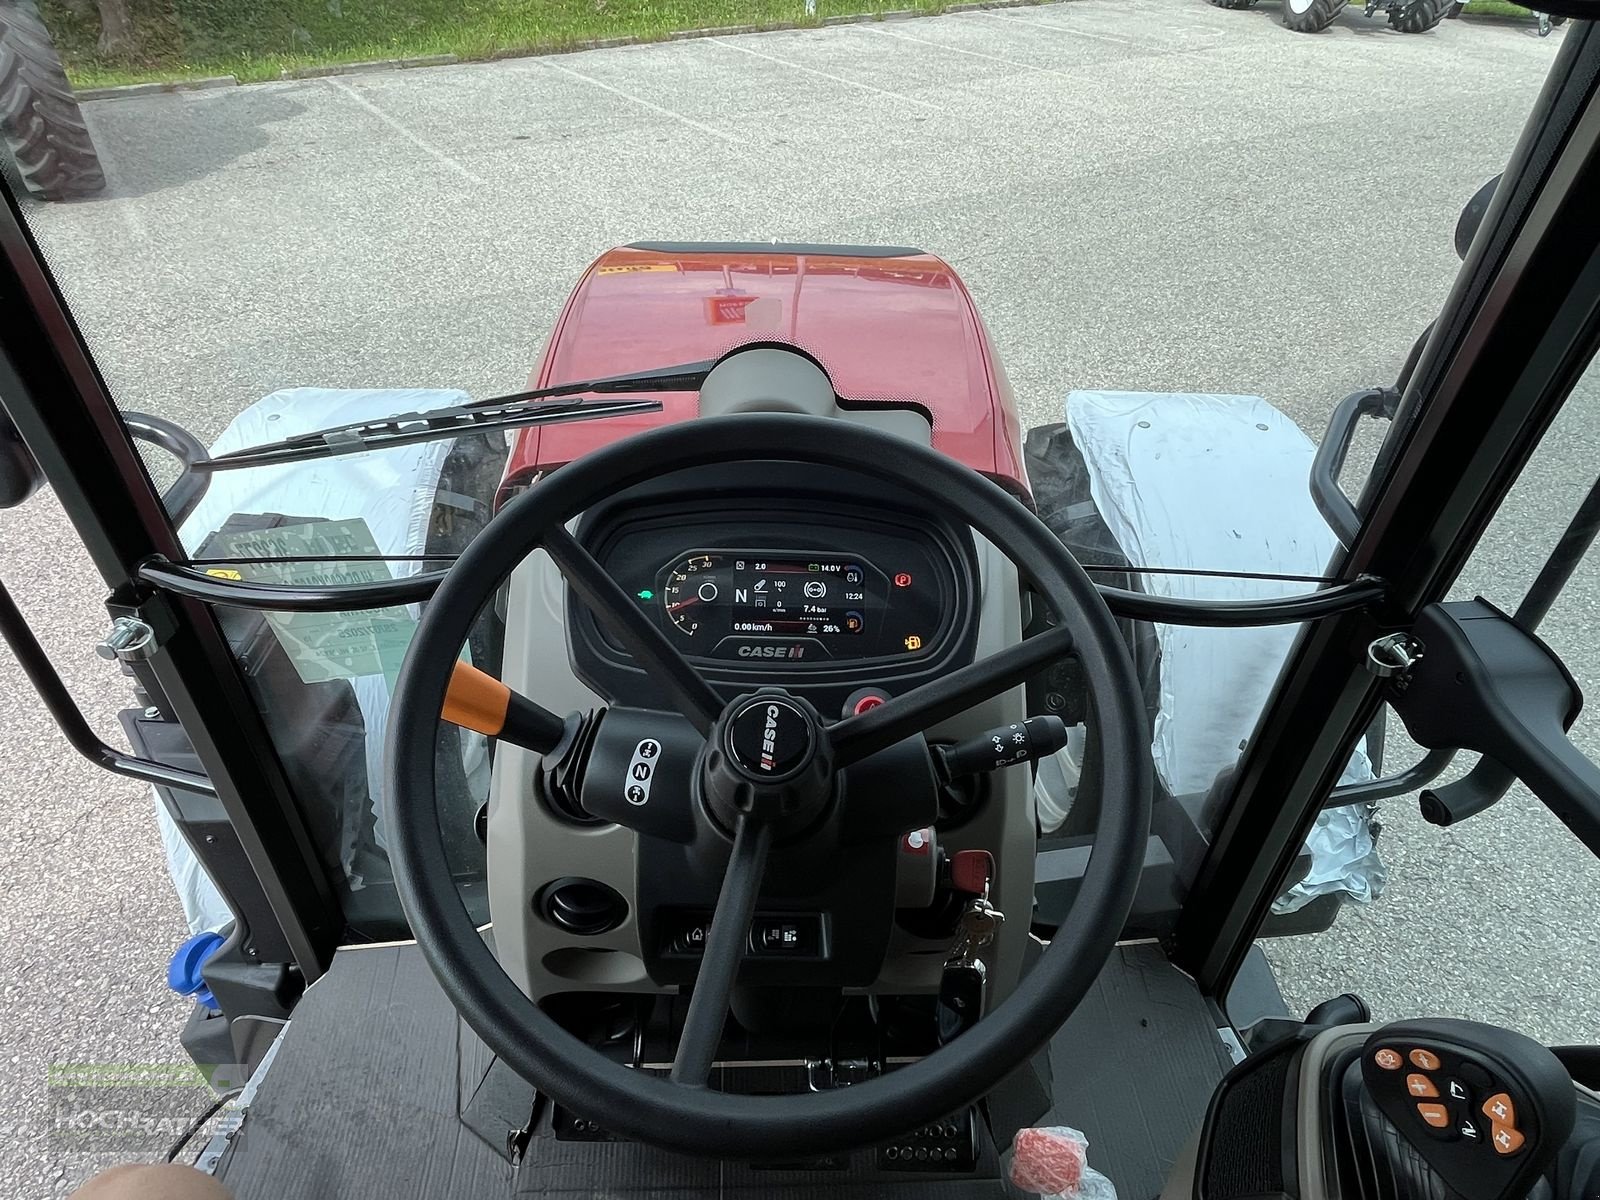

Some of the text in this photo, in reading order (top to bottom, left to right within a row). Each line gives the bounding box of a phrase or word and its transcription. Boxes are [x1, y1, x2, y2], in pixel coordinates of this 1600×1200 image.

[735, 588, 747, 603] N
[803, 605, 816, 613] 7.4
[823, 625, 840, 633] 26%
[738, 646, 787, 658] CASE
[762, 704, 780, 754] CASE
[634, 765, 649, 779] N
